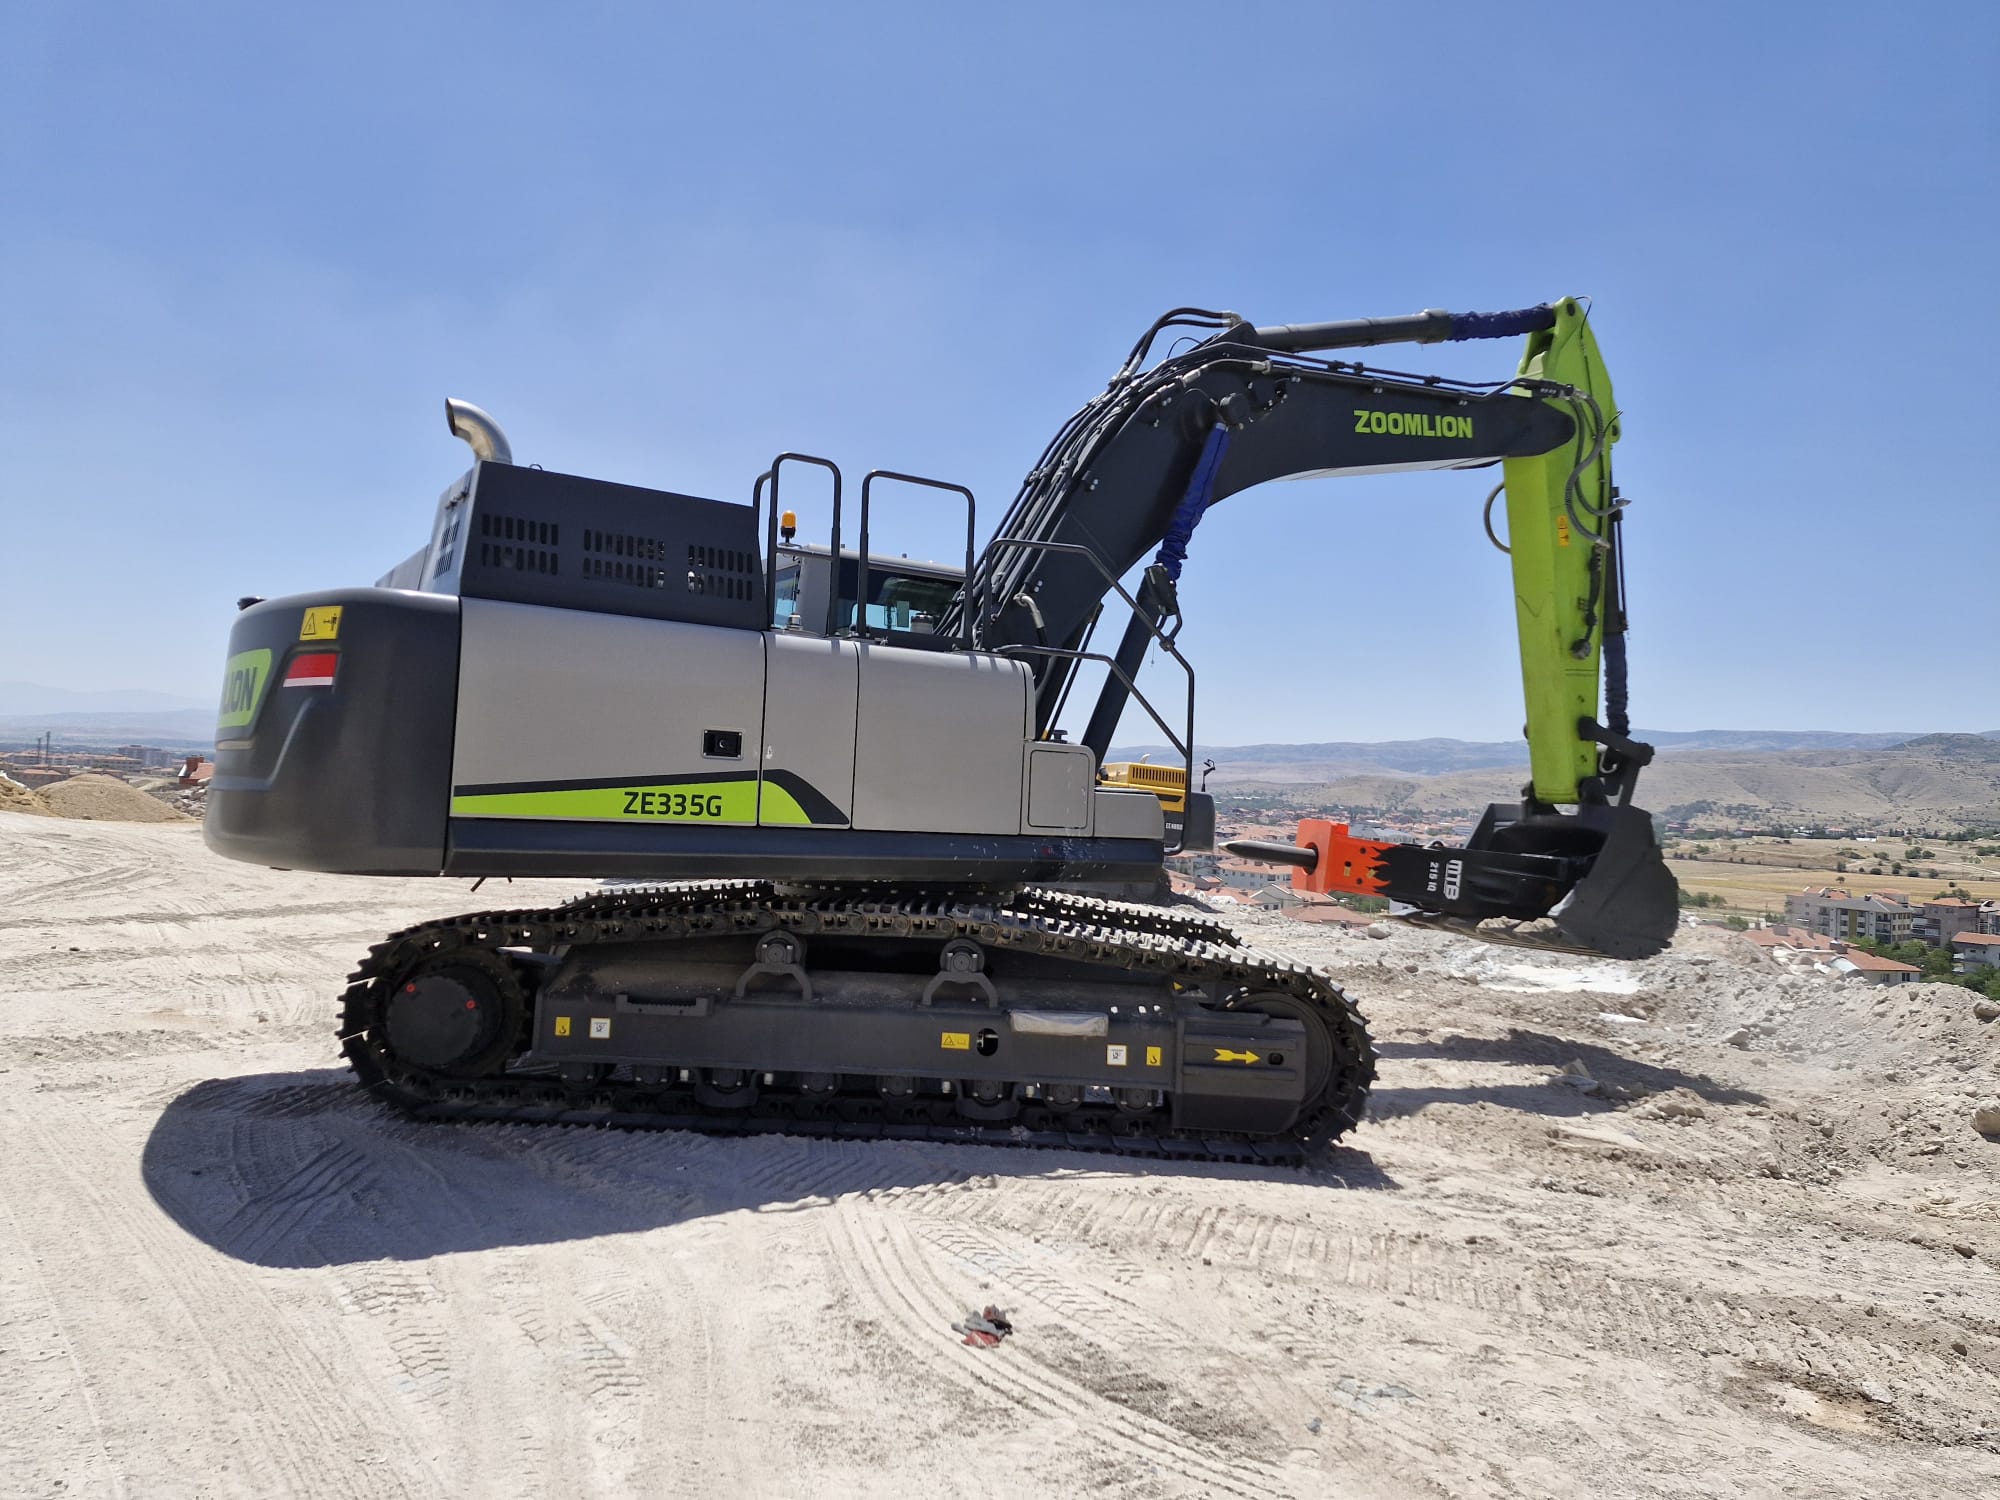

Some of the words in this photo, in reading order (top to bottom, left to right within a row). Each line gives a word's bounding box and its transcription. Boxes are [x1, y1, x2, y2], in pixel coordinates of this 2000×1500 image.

[1353, 410, 1473, 438] ZOOMLION
[623, 791, 722, 817] ZE335G
[1443, 859, 1463, 900] MTB
